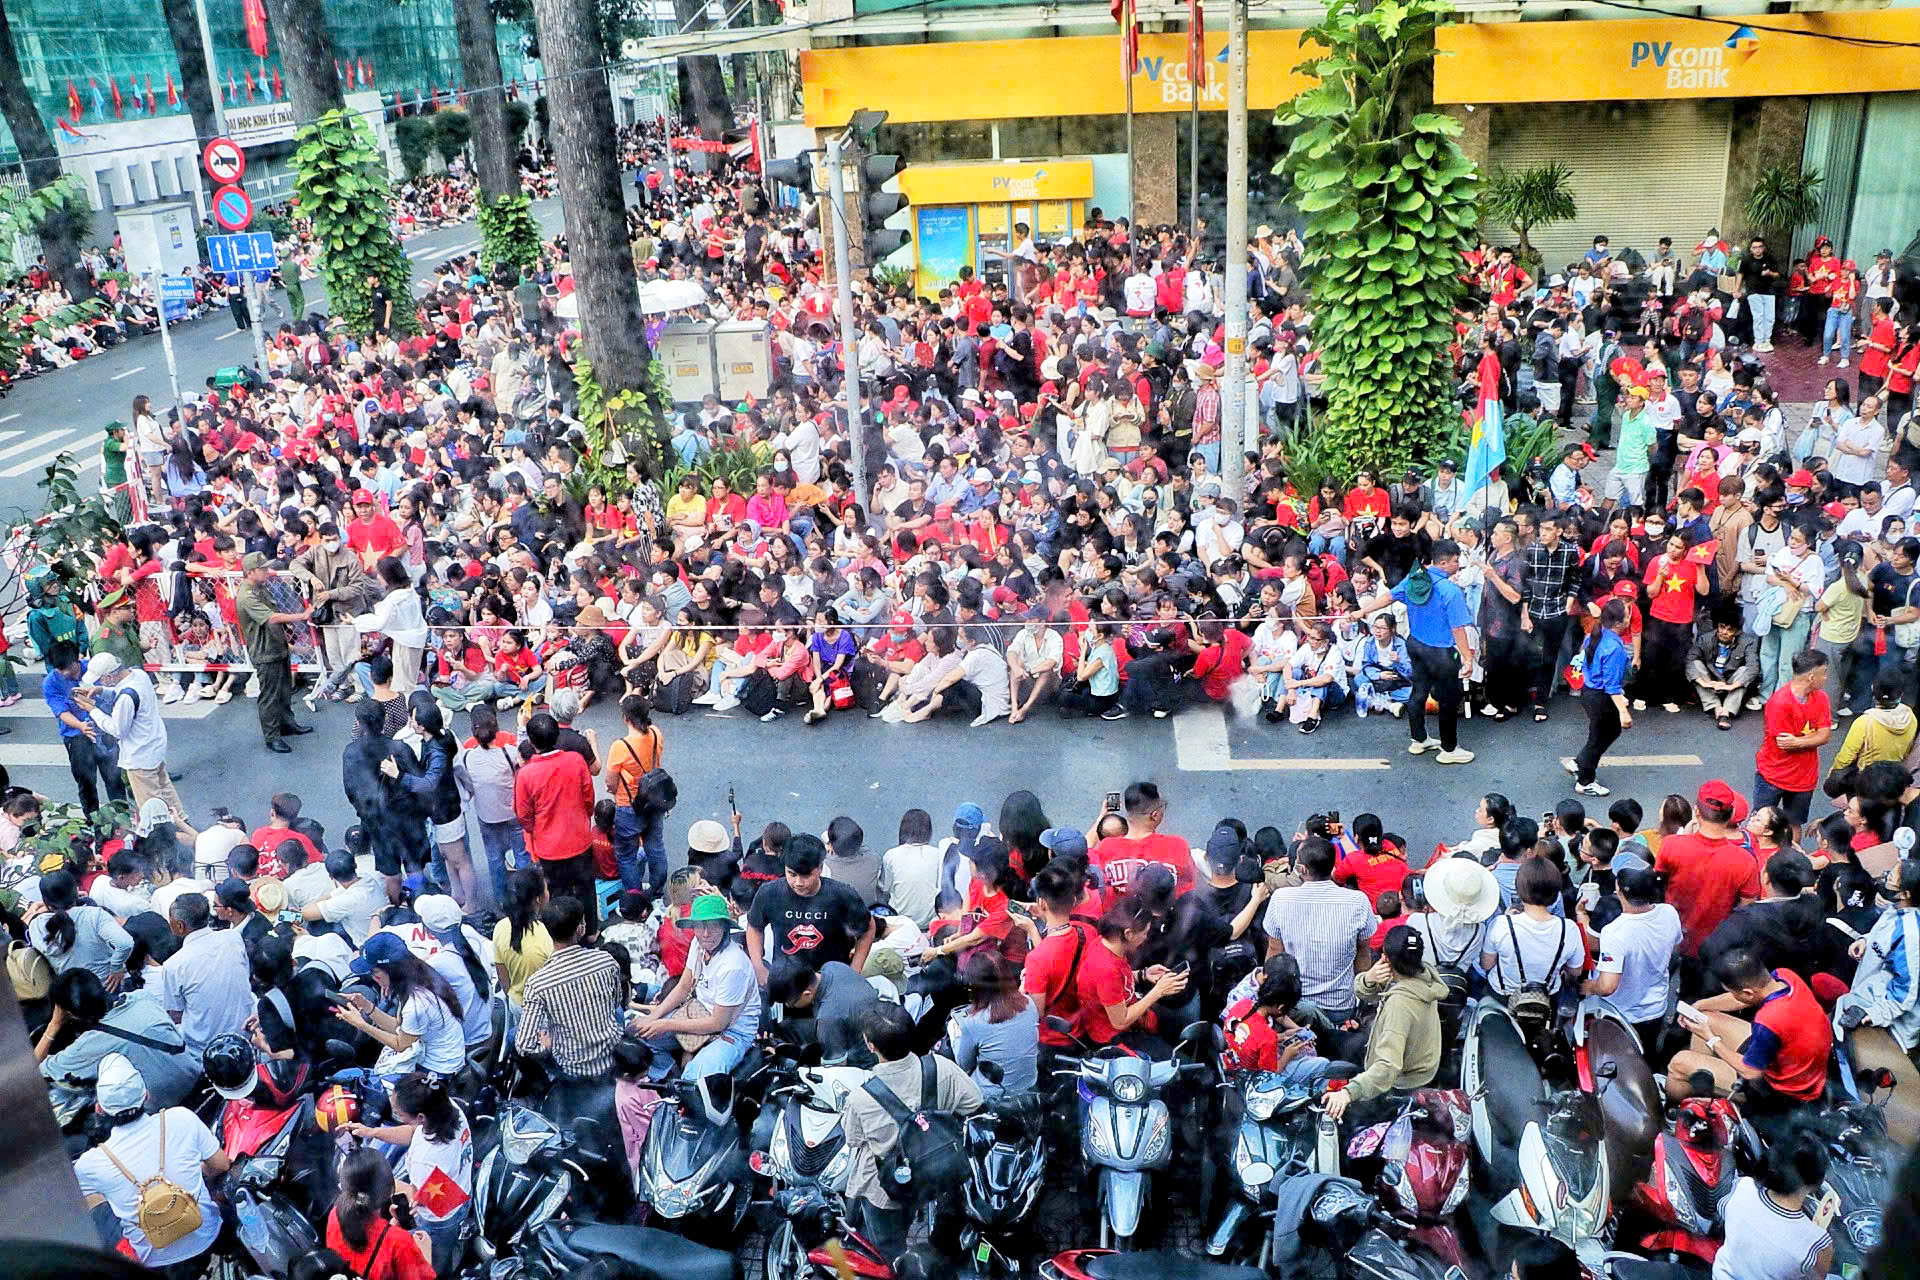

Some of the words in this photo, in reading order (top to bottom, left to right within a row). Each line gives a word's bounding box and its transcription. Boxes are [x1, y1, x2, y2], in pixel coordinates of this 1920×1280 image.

[1631, 41, 1723, 68] PVcom
[1667, 68, 1729, 89] Bank
[785, 910, 828, 920] GUCCI
